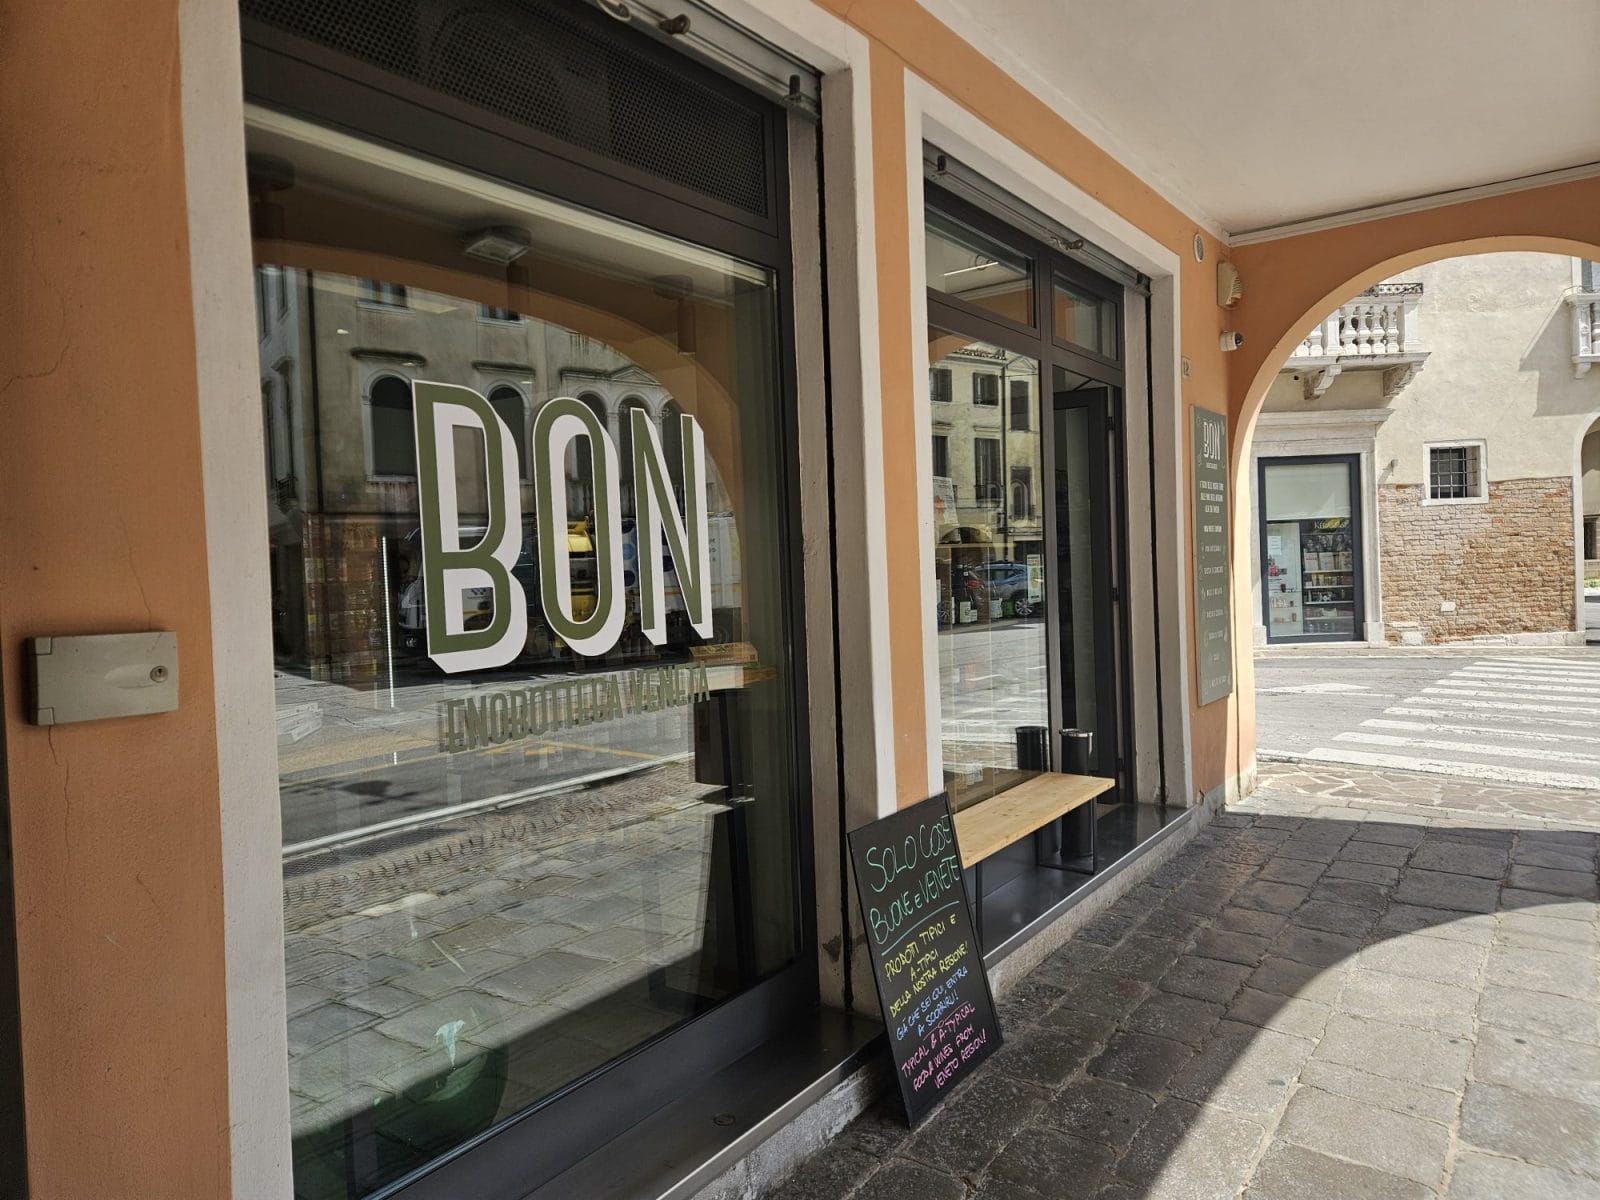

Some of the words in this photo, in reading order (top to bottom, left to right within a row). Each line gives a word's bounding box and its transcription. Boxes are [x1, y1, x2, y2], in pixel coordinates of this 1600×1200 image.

[1203, 421, 1221, 460] BON
[412, 379, 714, 673] BON
[445, 673, 624, 753] ENOBOTTEGA
[629, 660, 710, 715] VENETA
[866, 835, 917, 892] SOLO
[919, 814, 952, 858] COSE
[869, 891, 914, 944] BUONE
[919, 855, 960, 903] VENETE
[919, 921, 946, 945] TIPICI
[949, 914, 956, 924] E
[889, 990, 912, 1018] DELLA
[912, 967, 938, 995] NOSTRA
[945, 966, 968, 988] ENTRA
[901, 1045, 930, 1078] TYPICAL
[934, 1057, 959, 1089] VENETO
